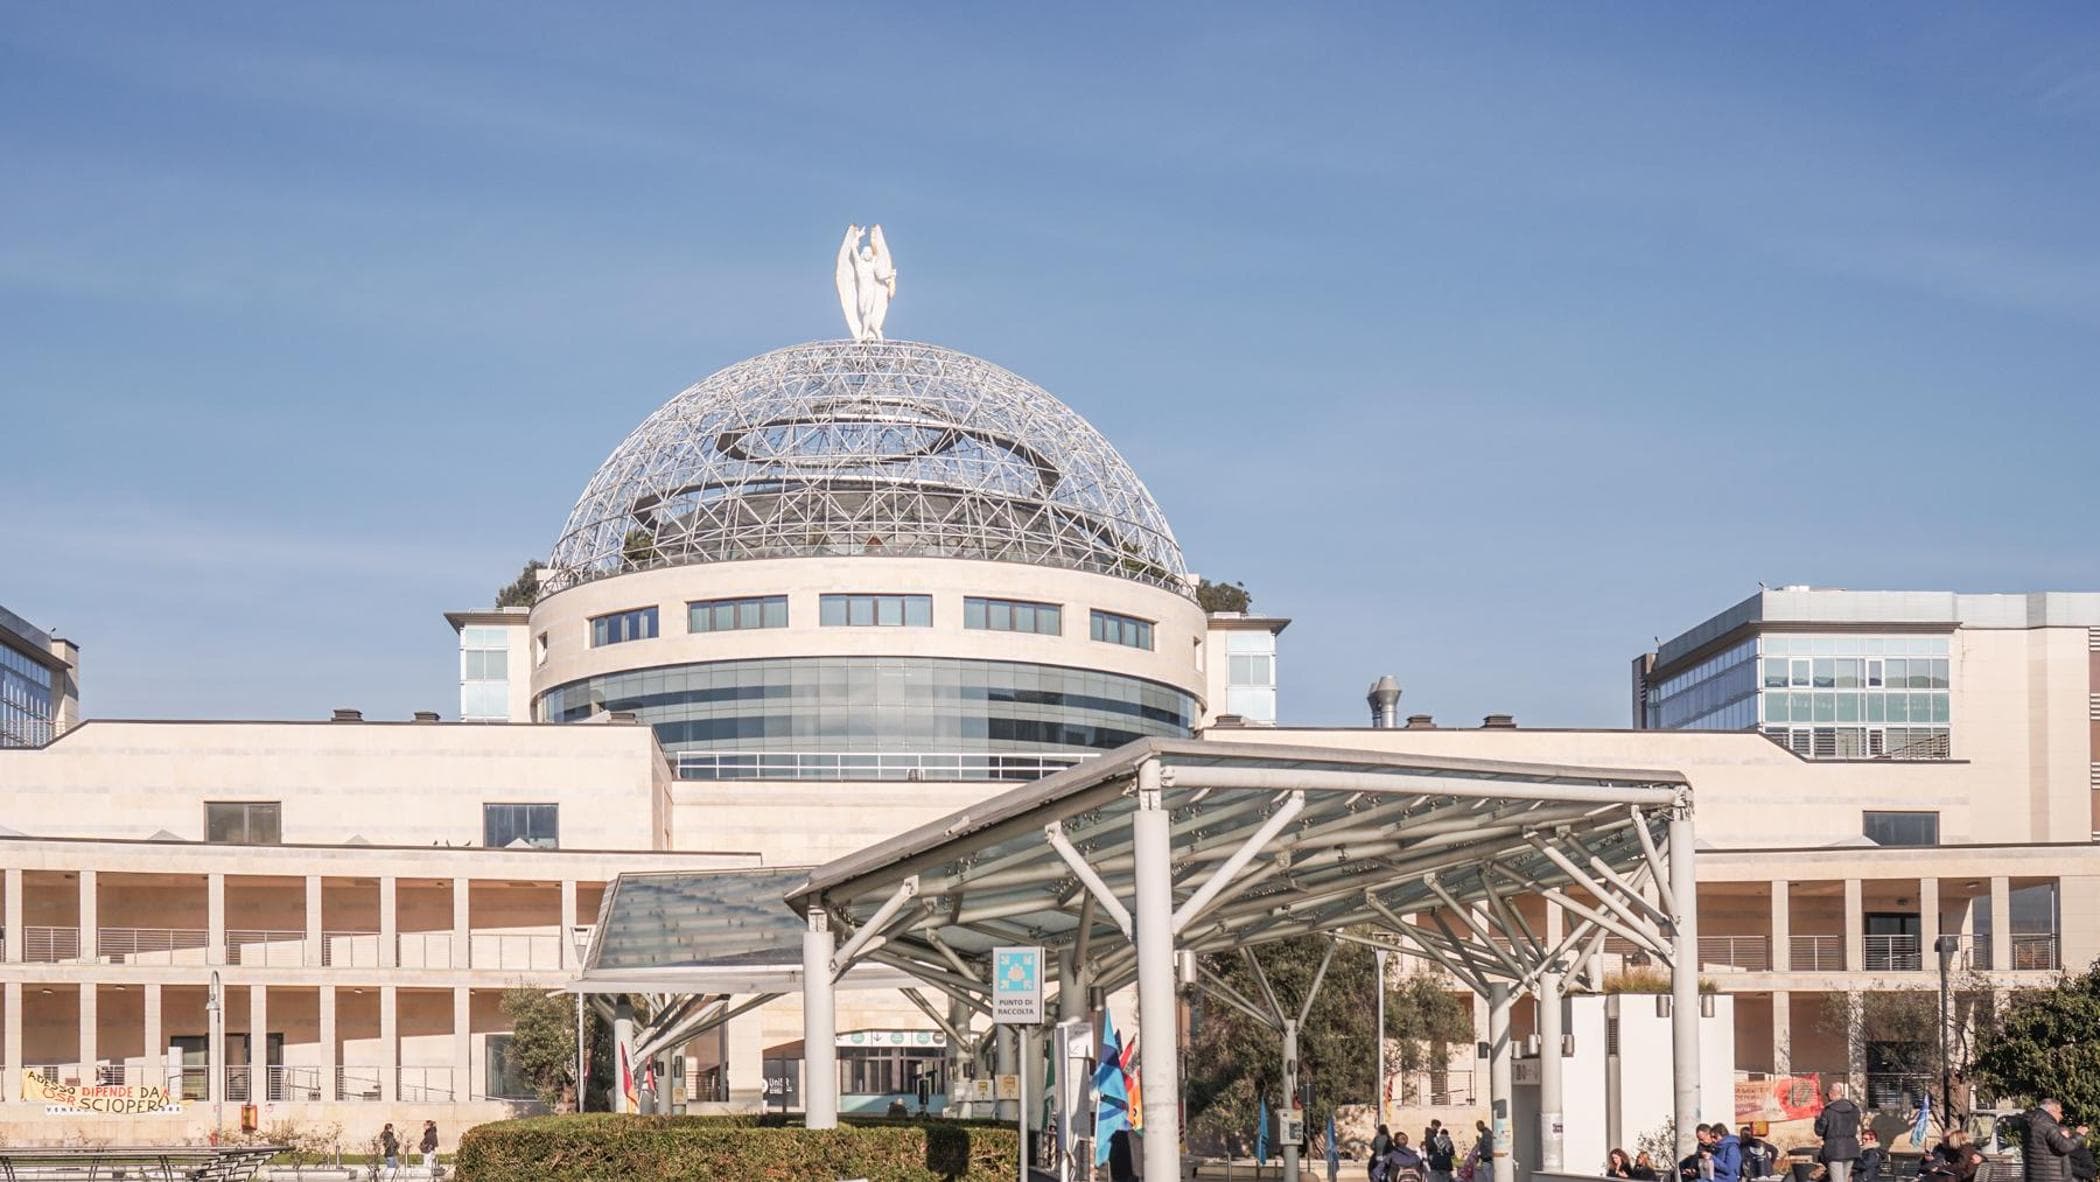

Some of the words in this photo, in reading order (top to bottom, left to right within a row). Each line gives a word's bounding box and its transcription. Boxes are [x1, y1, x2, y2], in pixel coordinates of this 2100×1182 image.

[28, 1071, 76, 1095] ADESSO
[82, 1086, 133, 1098] DIPENDE
[79, 1096, 170, 1114] SCIOPERO
